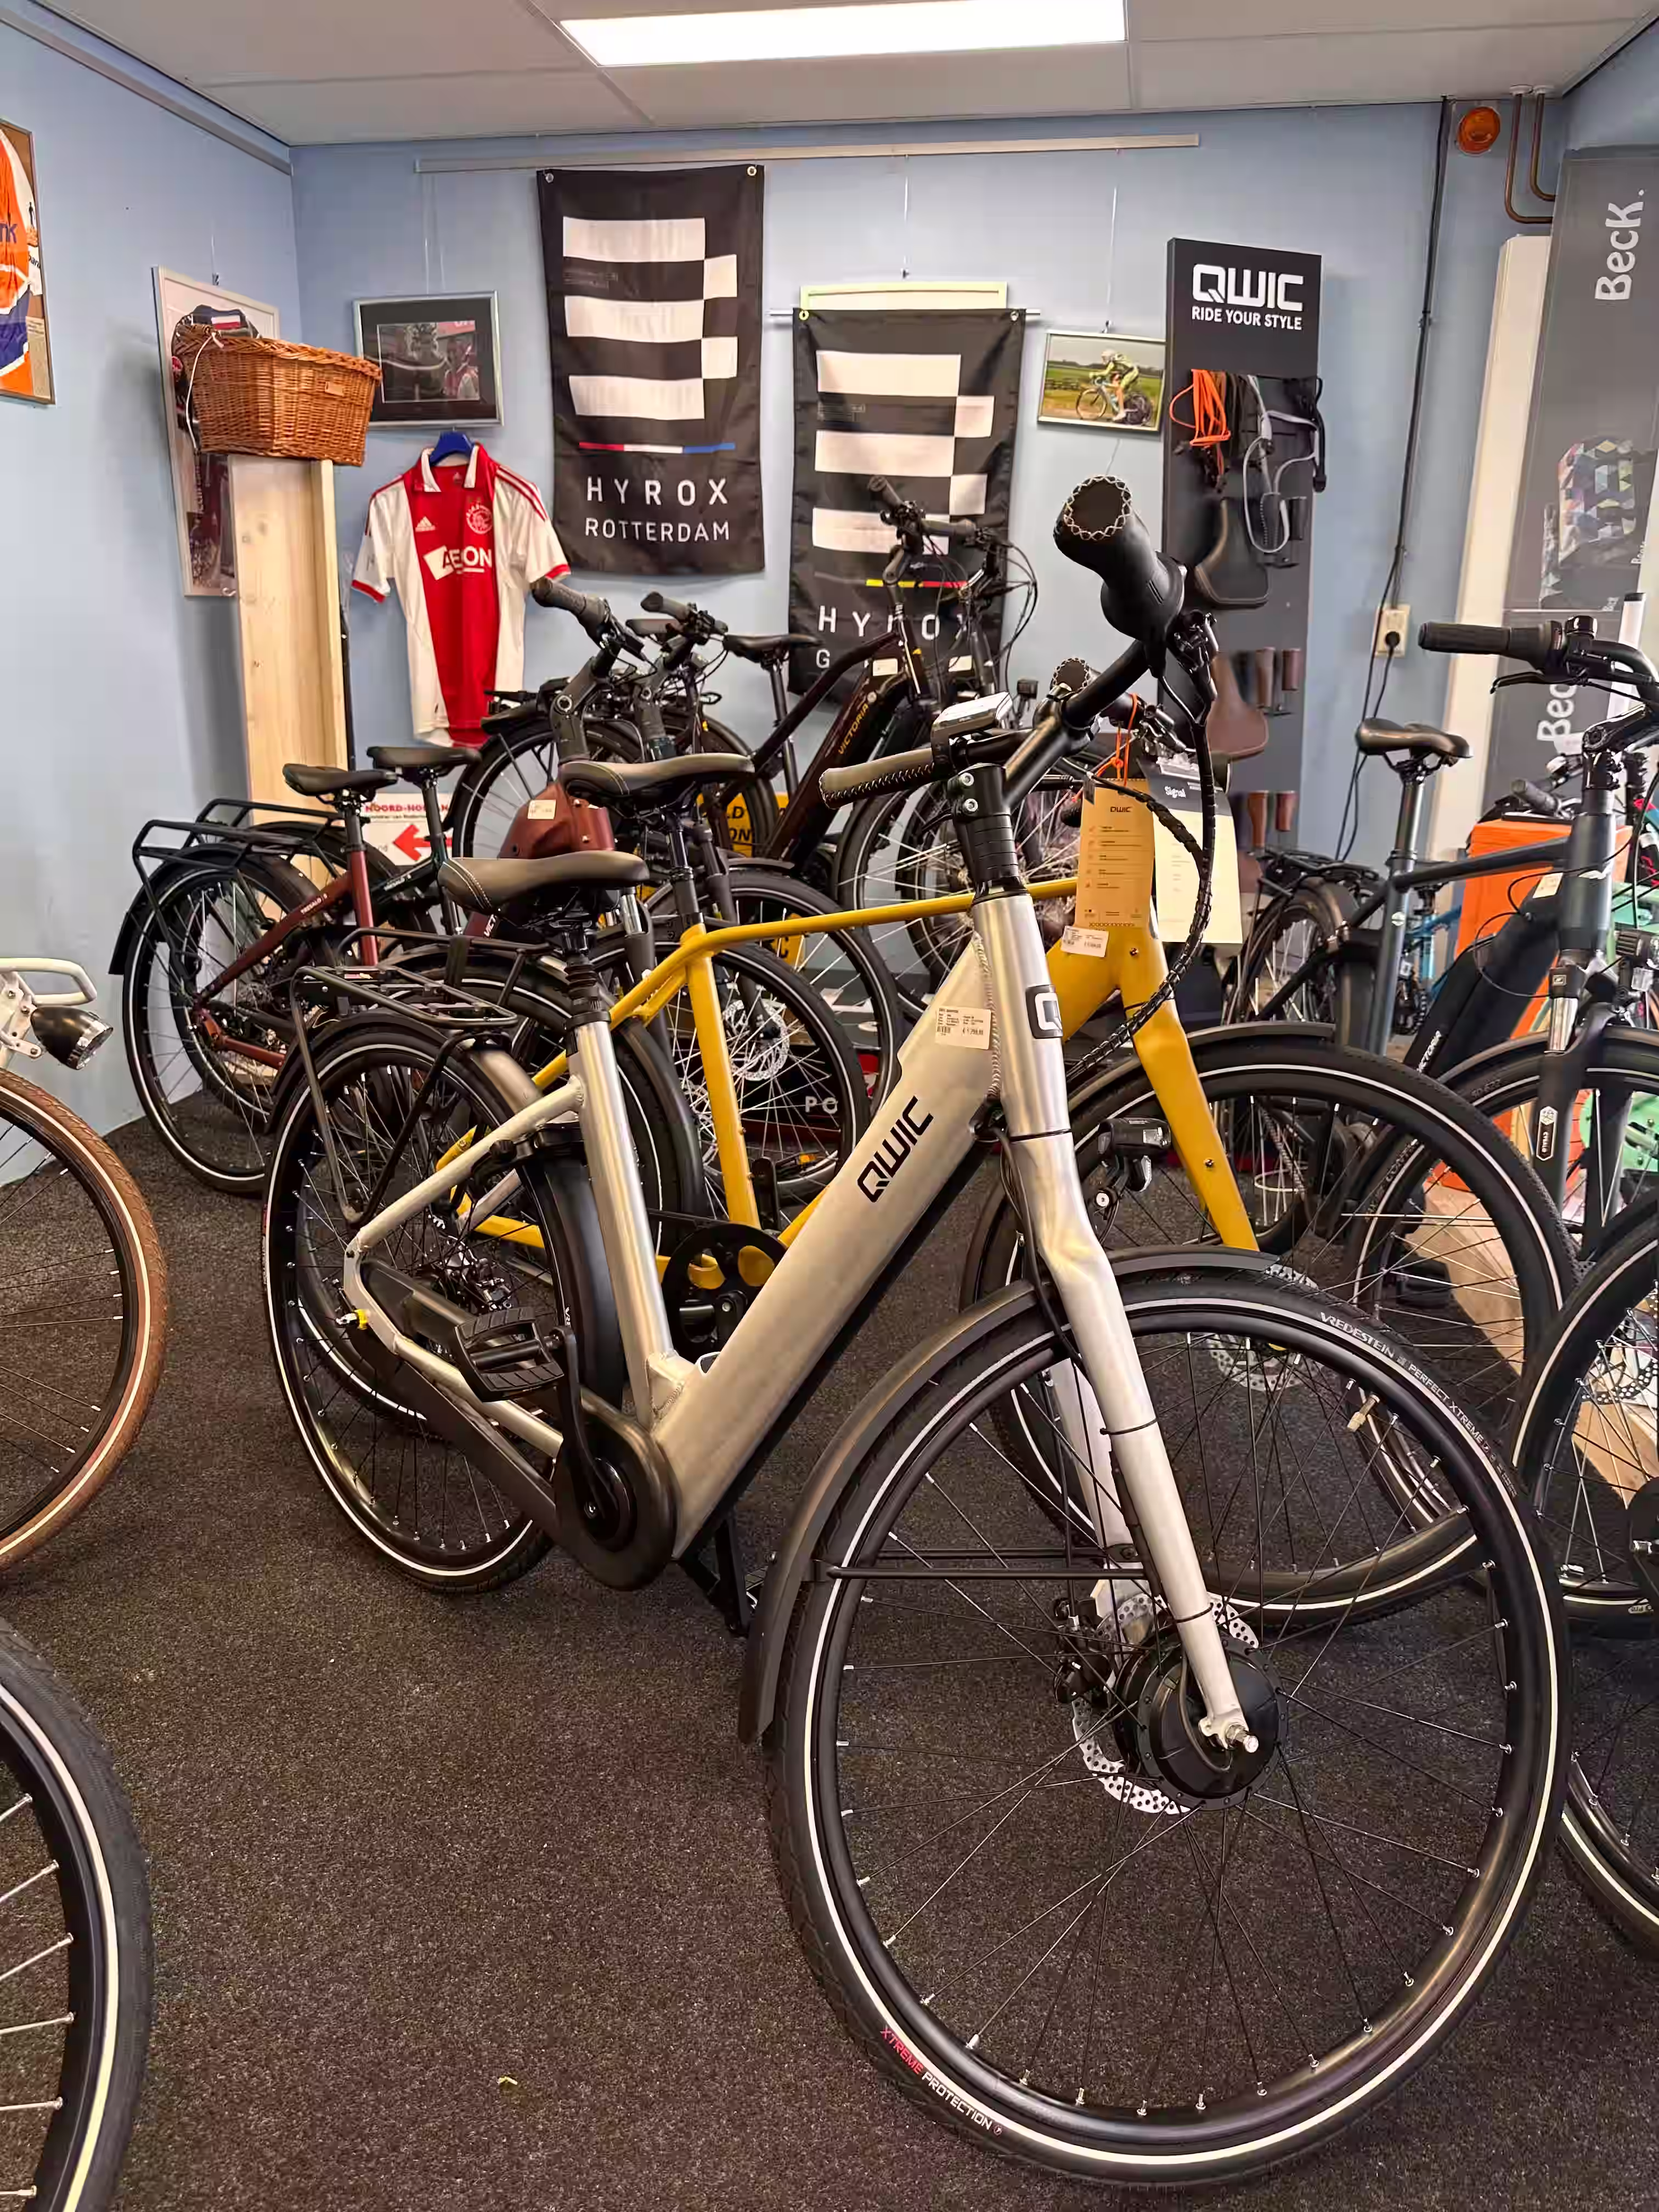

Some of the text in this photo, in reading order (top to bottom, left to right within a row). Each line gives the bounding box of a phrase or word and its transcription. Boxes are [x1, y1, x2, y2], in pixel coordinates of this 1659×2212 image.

[1594, 189, 1644, 300] Beck.
[1192, 263, 1304, 312] QWIC
[1192, 306, 1302, 330] RIDE YOUR STYLE
[586, 476, 728, 506] HYROX
[585, 517, 730, 542] ROTTERDAM
[442, 545, 493, 571] AEON
[838, 704, 870, 755] VICTORIA
[857, 1096, 934, 1203] QWIC
[1320, 1312, 1485, 1445] VREDESTEIN PERFECT XTREME
[880, 2025, 992, 2130] XTREME PROTECTION
